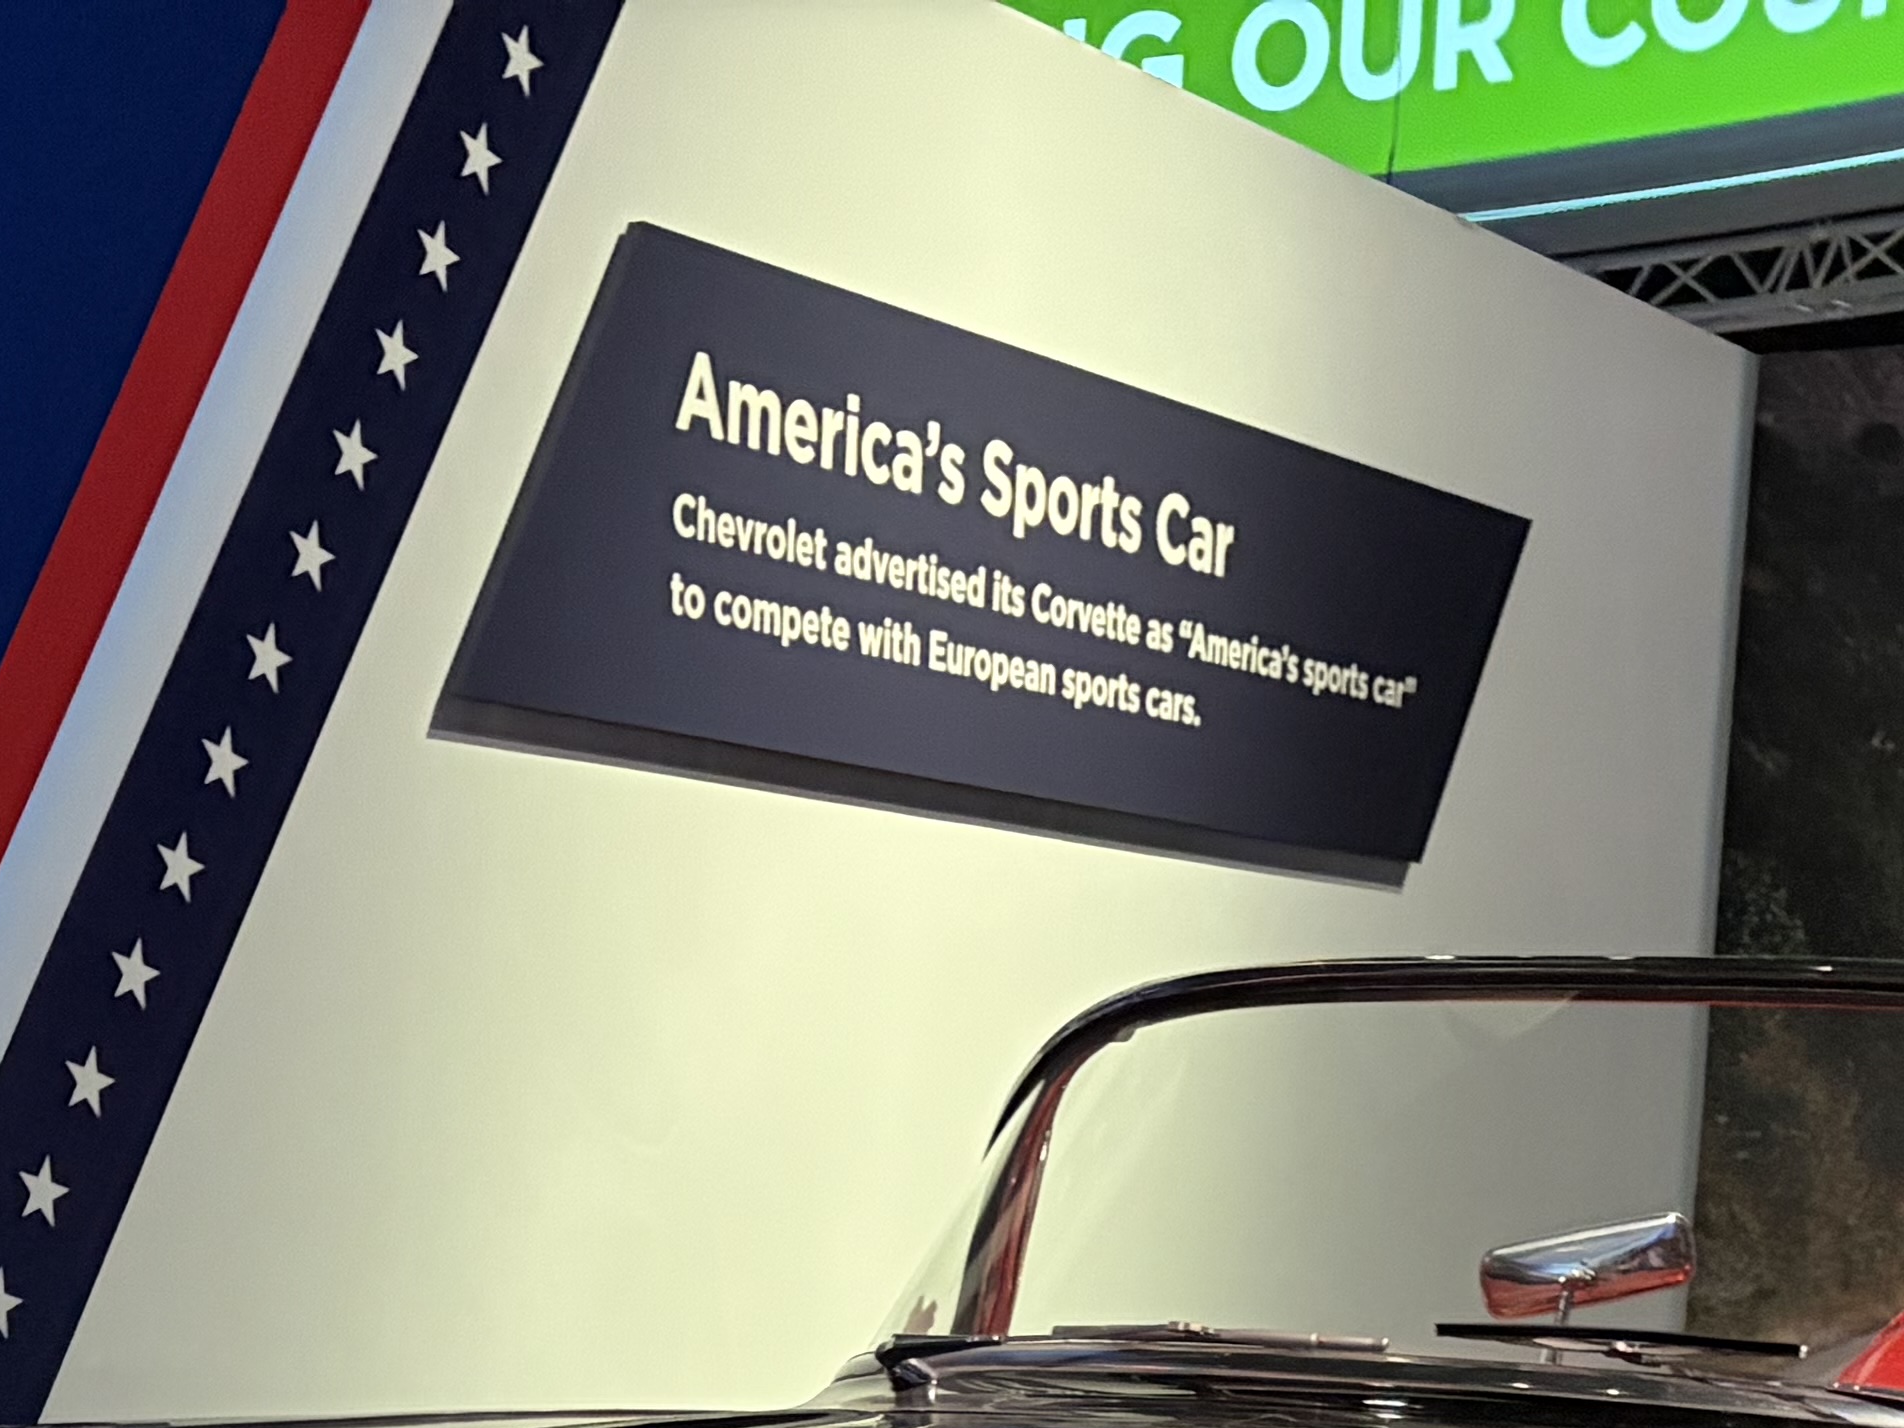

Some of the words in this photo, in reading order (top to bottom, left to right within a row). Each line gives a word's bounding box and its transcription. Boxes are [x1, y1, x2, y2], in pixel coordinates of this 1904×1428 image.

[1231, 0, 1517, 112] OUR
[674, 350, 967, 506] America’s
[979, 437, 1143, 554] Sports
[1155, 491, 1235, 578] Car
[669, 571, 706, 620] to
[712, 590, 853, 652] compete
[856, 615, 922, 668] with
[927, 628, 1057, 696] European
[1060, 666, 1143, 714] sports
[1144, 685, 1203, 728] cars.
[671, 492, 829, 572] Chevrolet
[833, 536, 987, 610] advertised
[991, 568, 1026, 618] its
[1030, 581, 1143, 646] Corvette
[1144, 617, 1175, 654] as
[1178, 617, 1300, 684] “America’s
[1301, 656, 1370, 701] sports
[1371, 674, 1418, 709] car”
